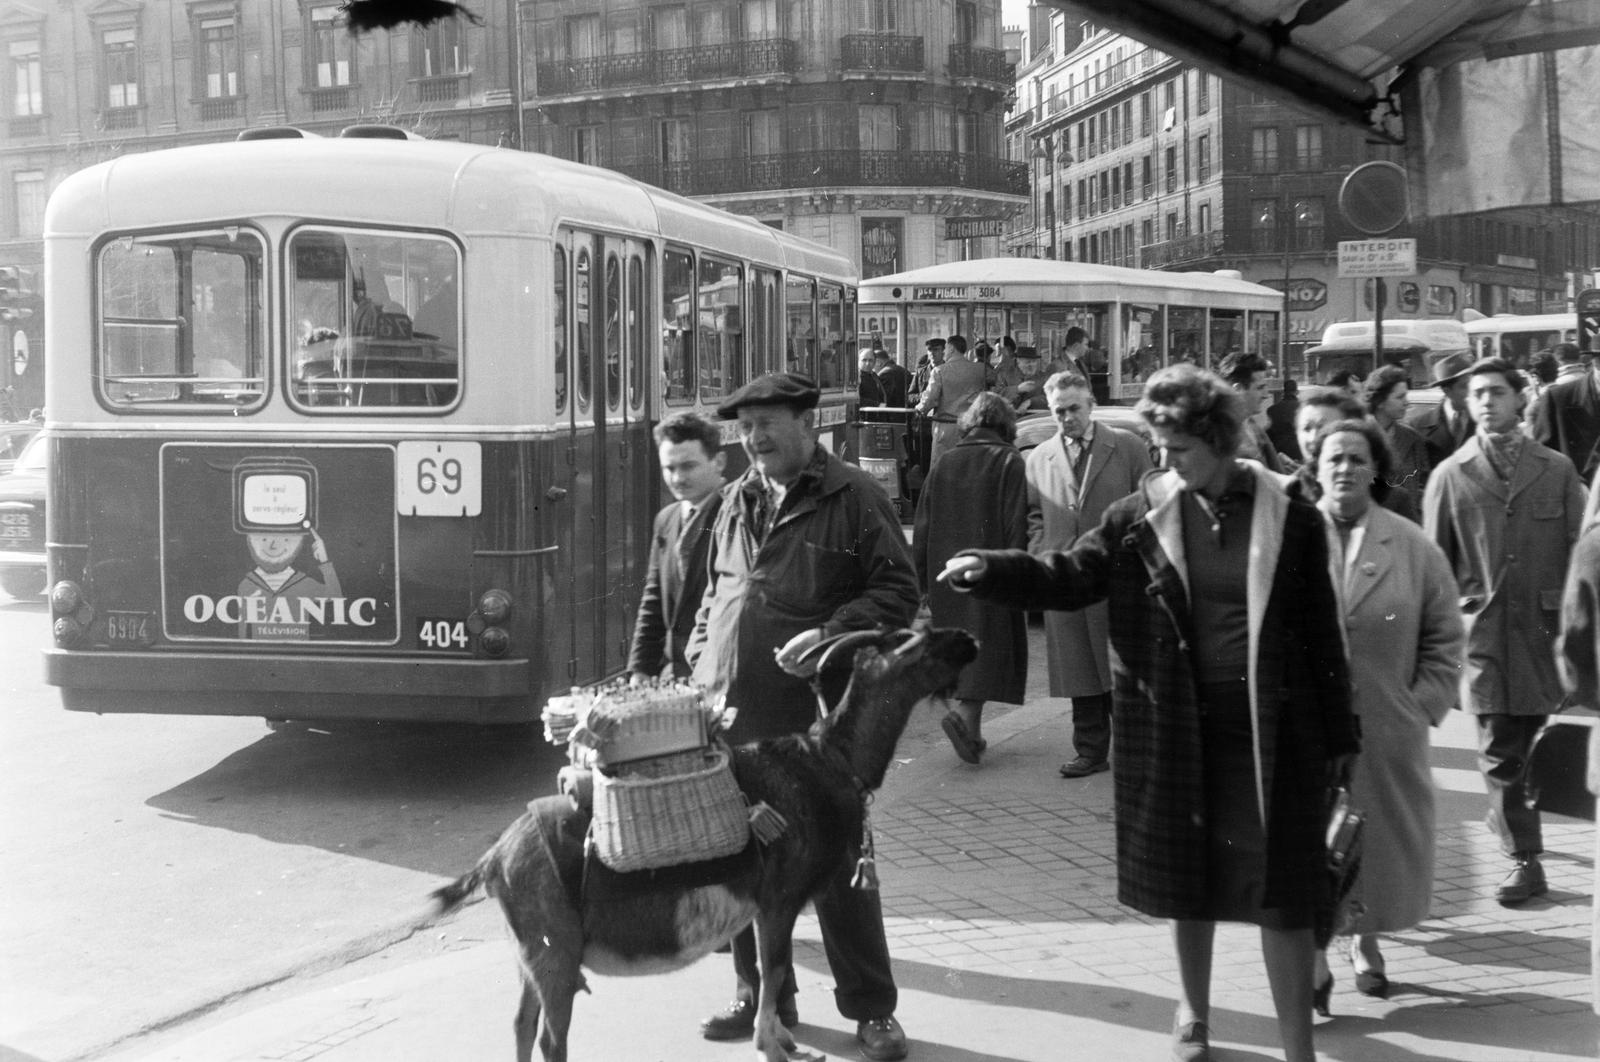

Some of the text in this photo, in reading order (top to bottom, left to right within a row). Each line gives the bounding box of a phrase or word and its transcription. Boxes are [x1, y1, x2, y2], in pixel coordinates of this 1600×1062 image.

[946, 220, 1003, 237] FRIGIDAIRE
[1343, 242, 1412, 252] INTERDIT
[979, 287, 1000, 298] 3084
[417, 457, 462, 495] 69
[183, 589, 377, 627] OCÉANIC
[419, 620, 468, 649] 404
